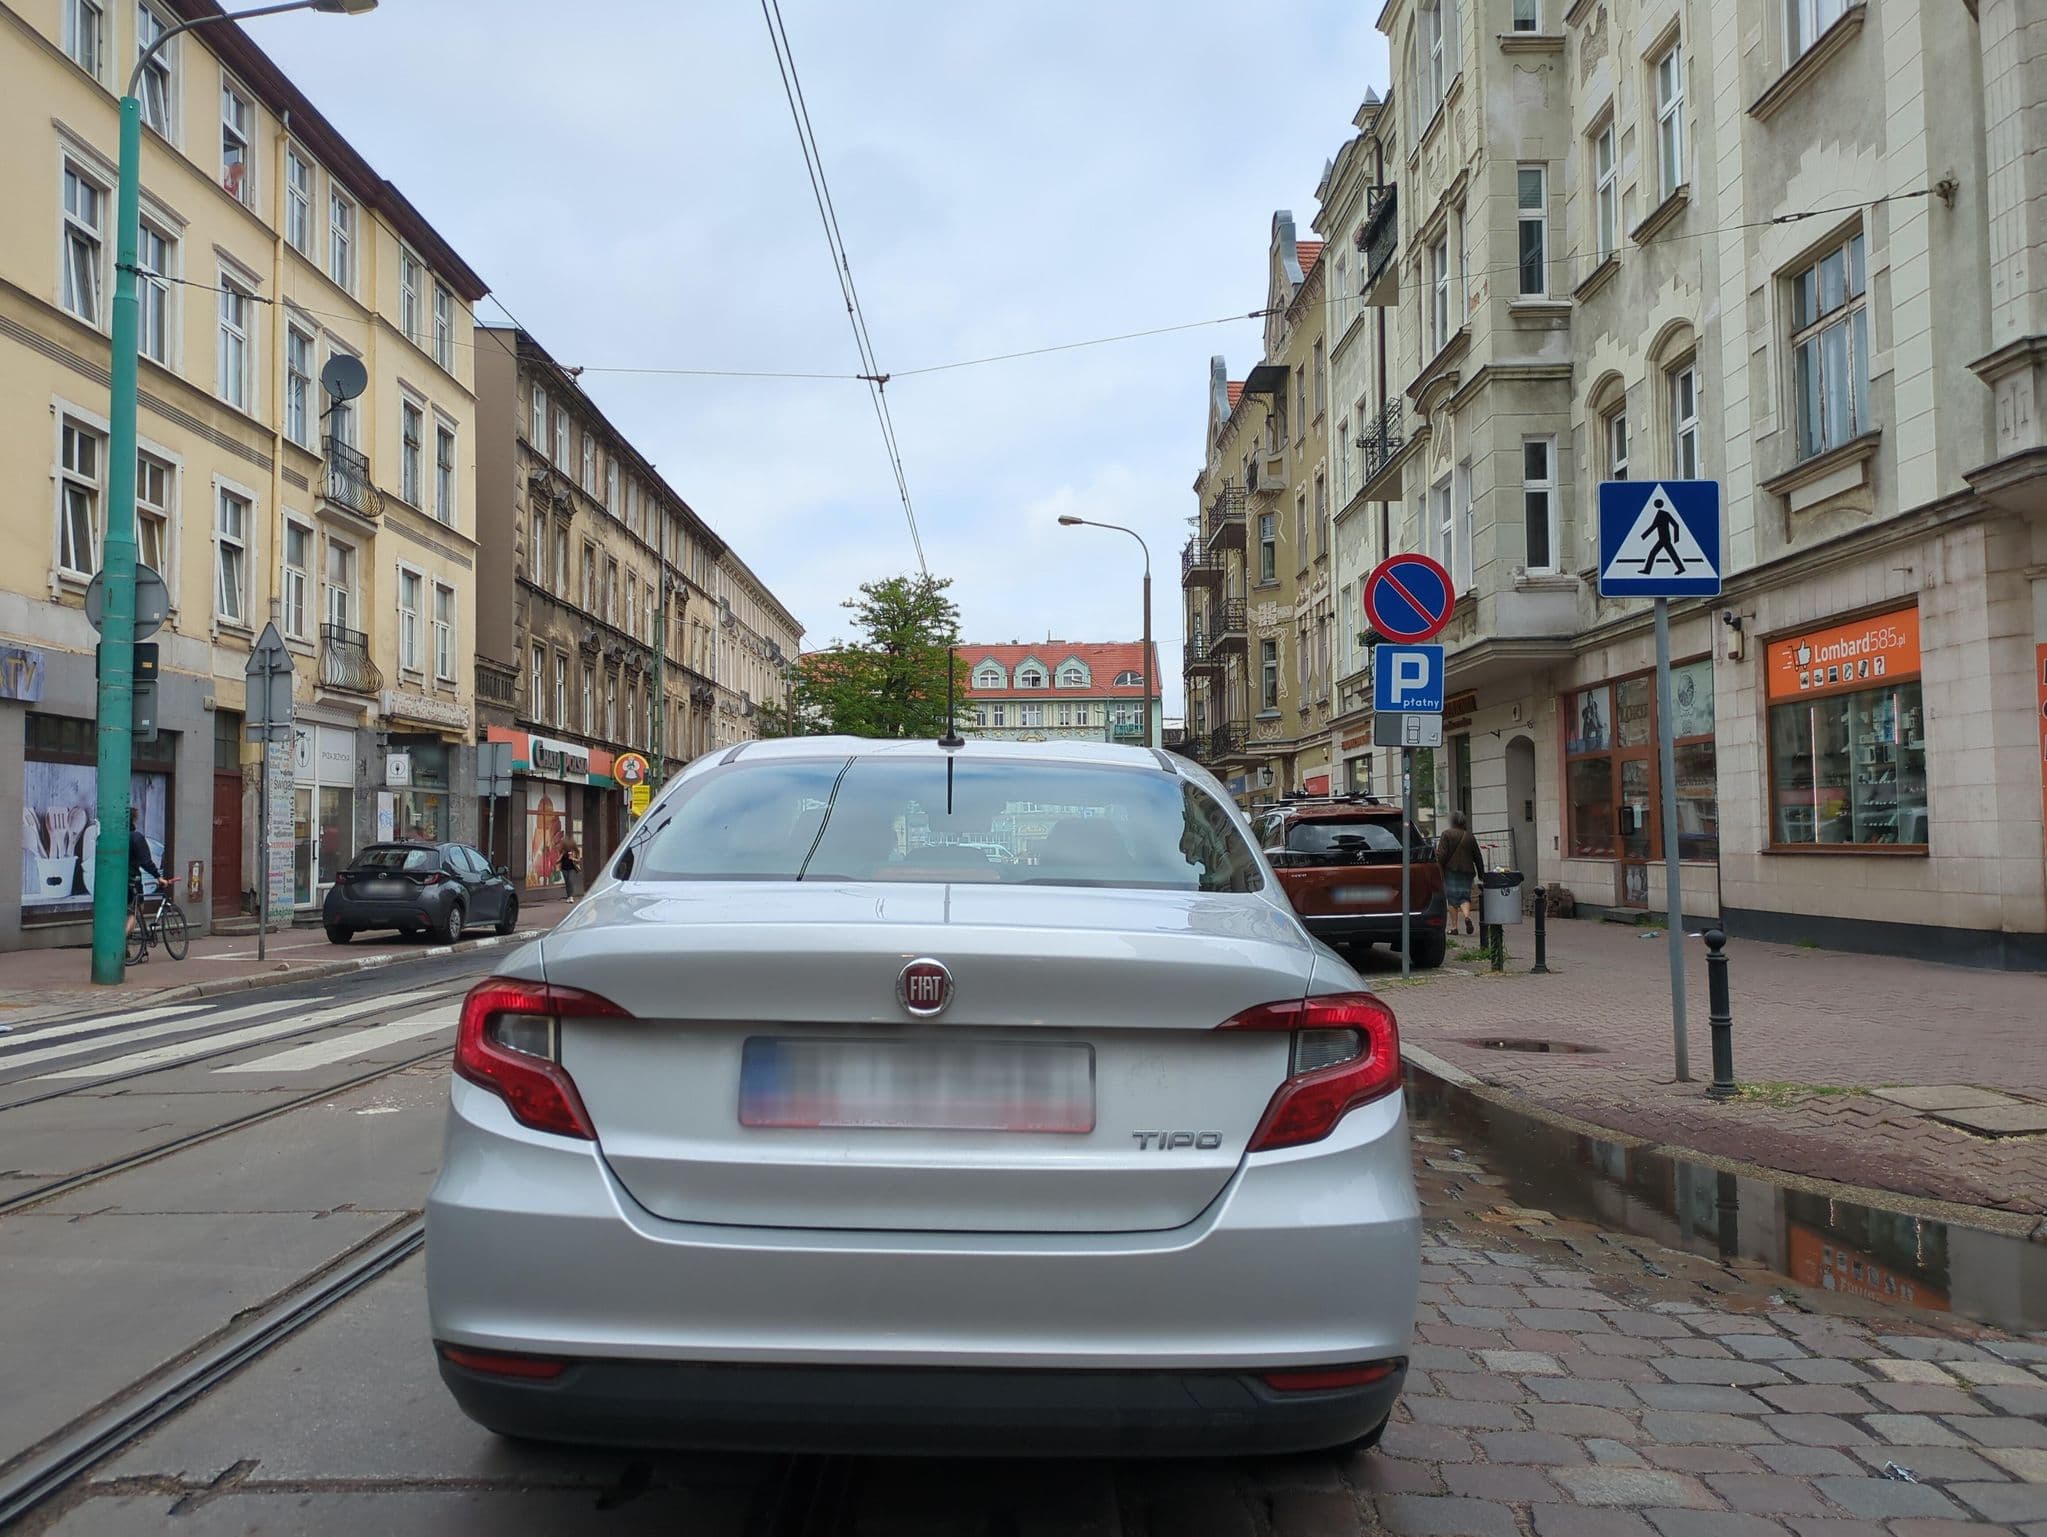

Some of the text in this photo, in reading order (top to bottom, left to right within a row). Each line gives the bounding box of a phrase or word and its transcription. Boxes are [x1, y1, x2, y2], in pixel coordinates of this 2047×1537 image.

[1815, 627, 1906, 663] Lombard585.pl
[0, 655, 37, 693] TY
[1391, 653, 1429, 703] P
[1403, 697, 1440, 709] płatny
[910, 976, 942, 1000] FIAT
[1131, 1130, 1223, 1150] TIPO
